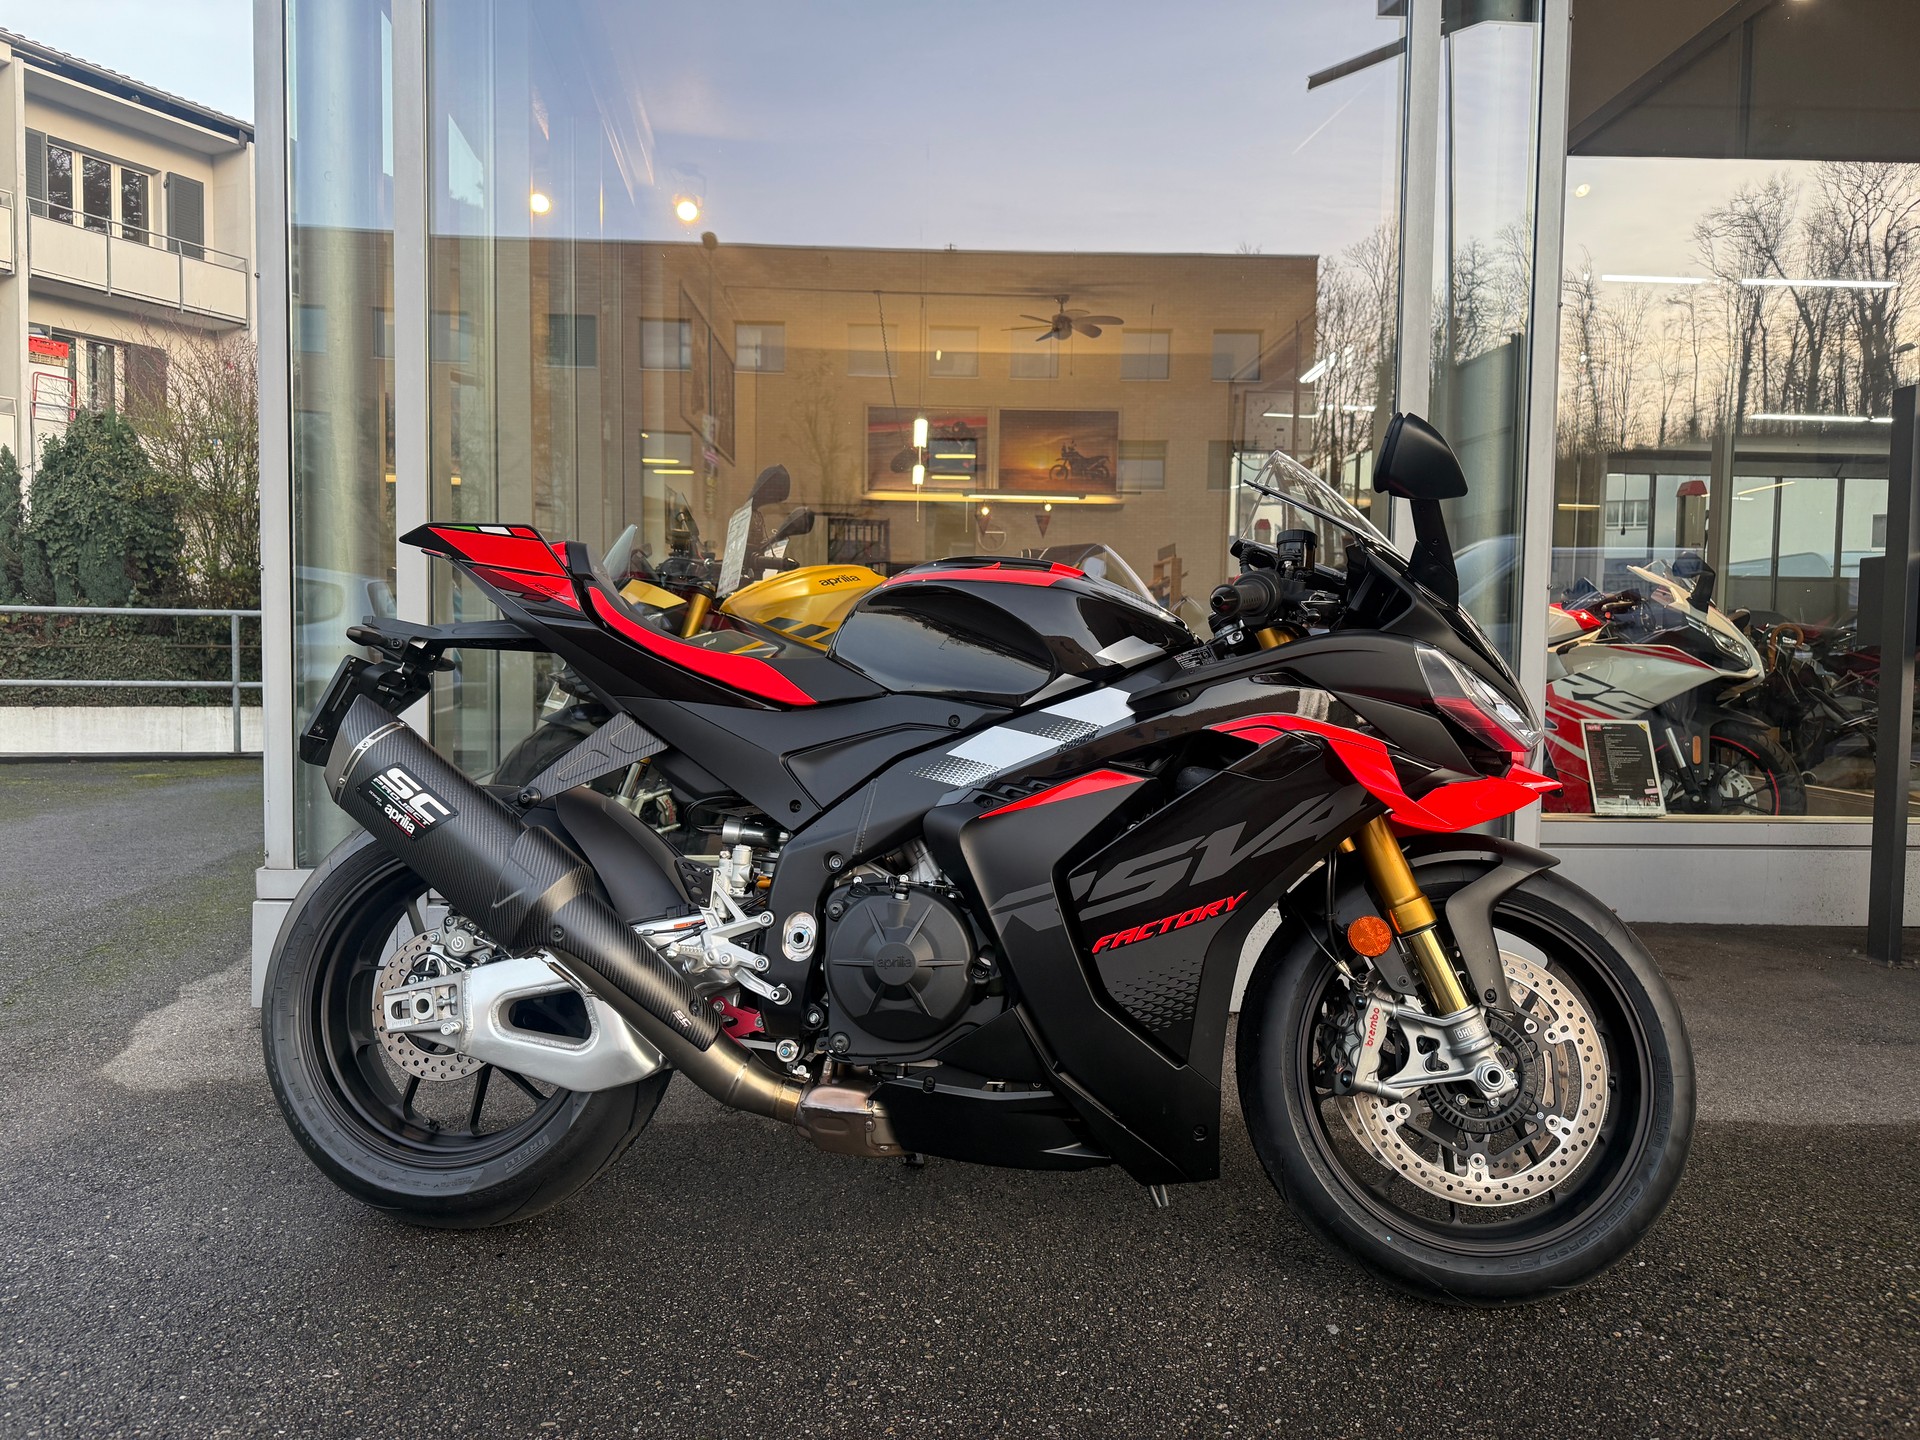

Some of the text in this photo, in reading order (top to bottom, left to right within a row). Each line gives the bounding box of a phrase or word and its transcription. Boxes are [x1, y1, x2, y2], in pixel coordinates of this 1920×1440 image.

[818, 573, 861, 587] aprilia
[372, 777, 431, 826] PROJECT
[378, 767, 451, 823] SC
[384, 803, 416, 834] aprilia
[1091, 890, 1249, 954] FACTORY
[876, 955, 913, 970] aprilia
[1365, 1007, 1380, 1047] brembo
[1545, 1184, 1642, 1264] SUPERCORSA
